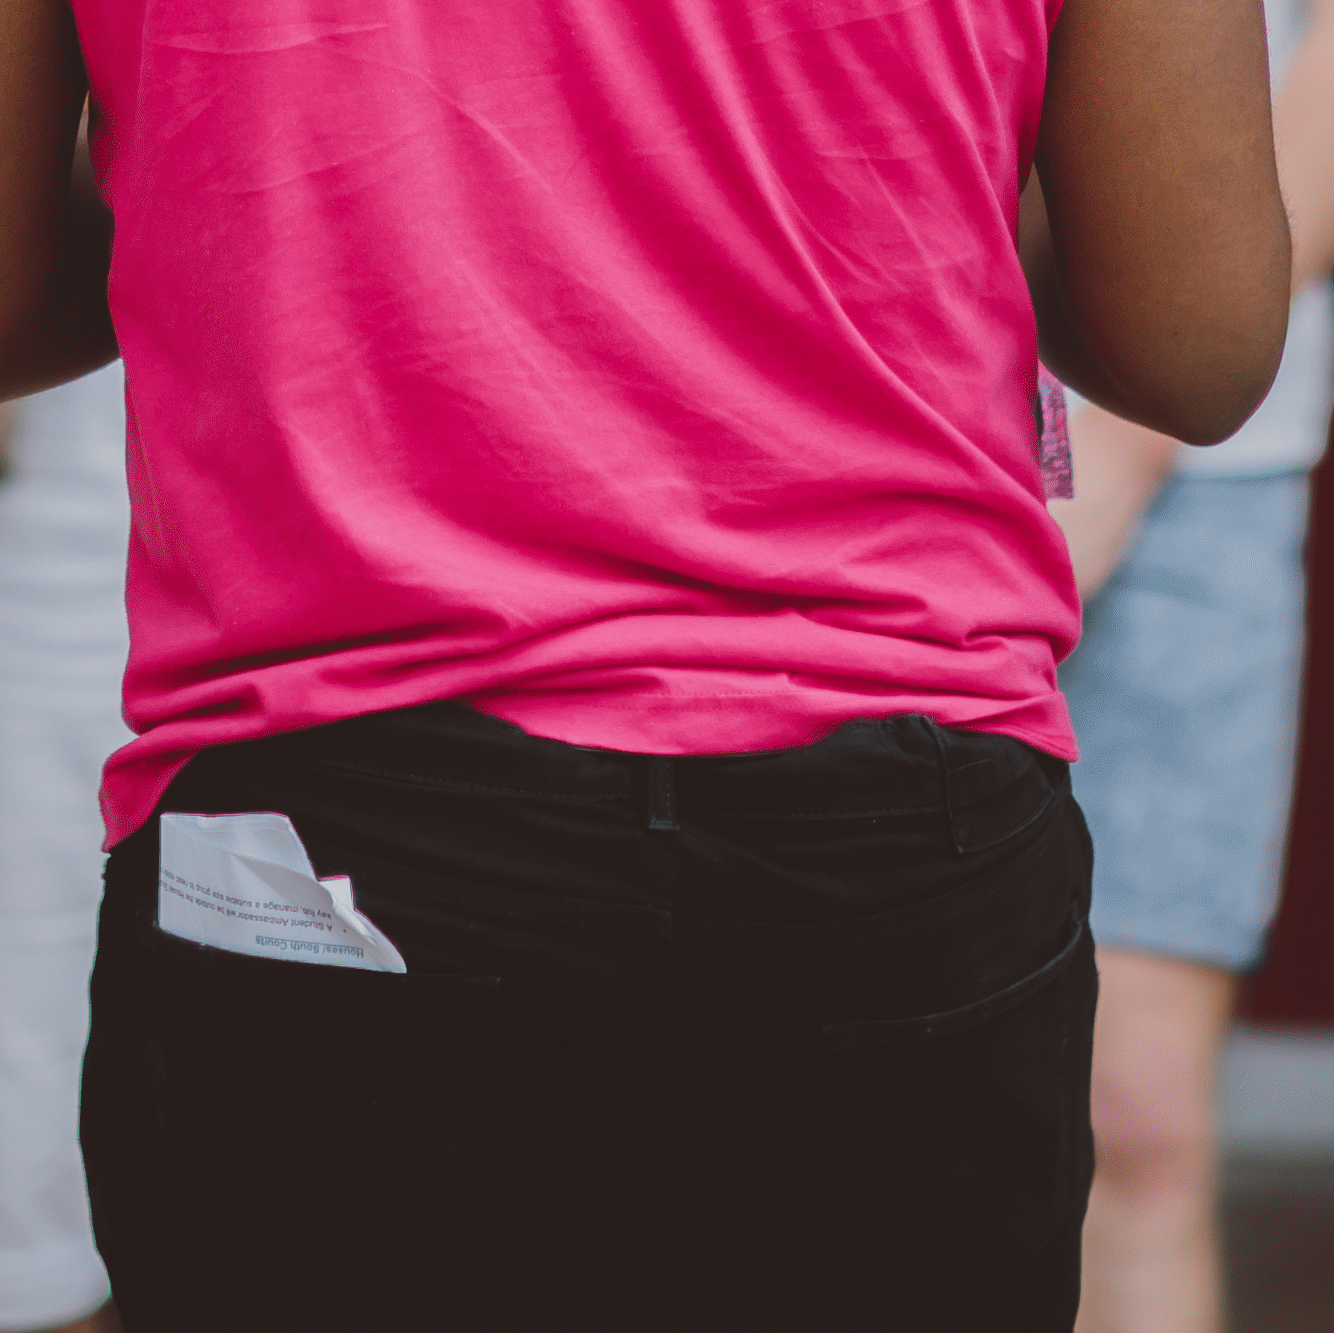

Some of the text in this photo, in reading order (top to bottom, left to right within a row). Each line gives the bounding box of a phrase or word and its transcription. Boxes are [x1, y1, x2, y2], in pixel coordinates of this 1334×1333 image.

[263, 901, 298, 912] manage
[237, 912, 289, 926] Ambassador
[291, 919, 324, 930] Student
[255, 935, 287, 950] Courts
[290, 940, 320, 954] South
